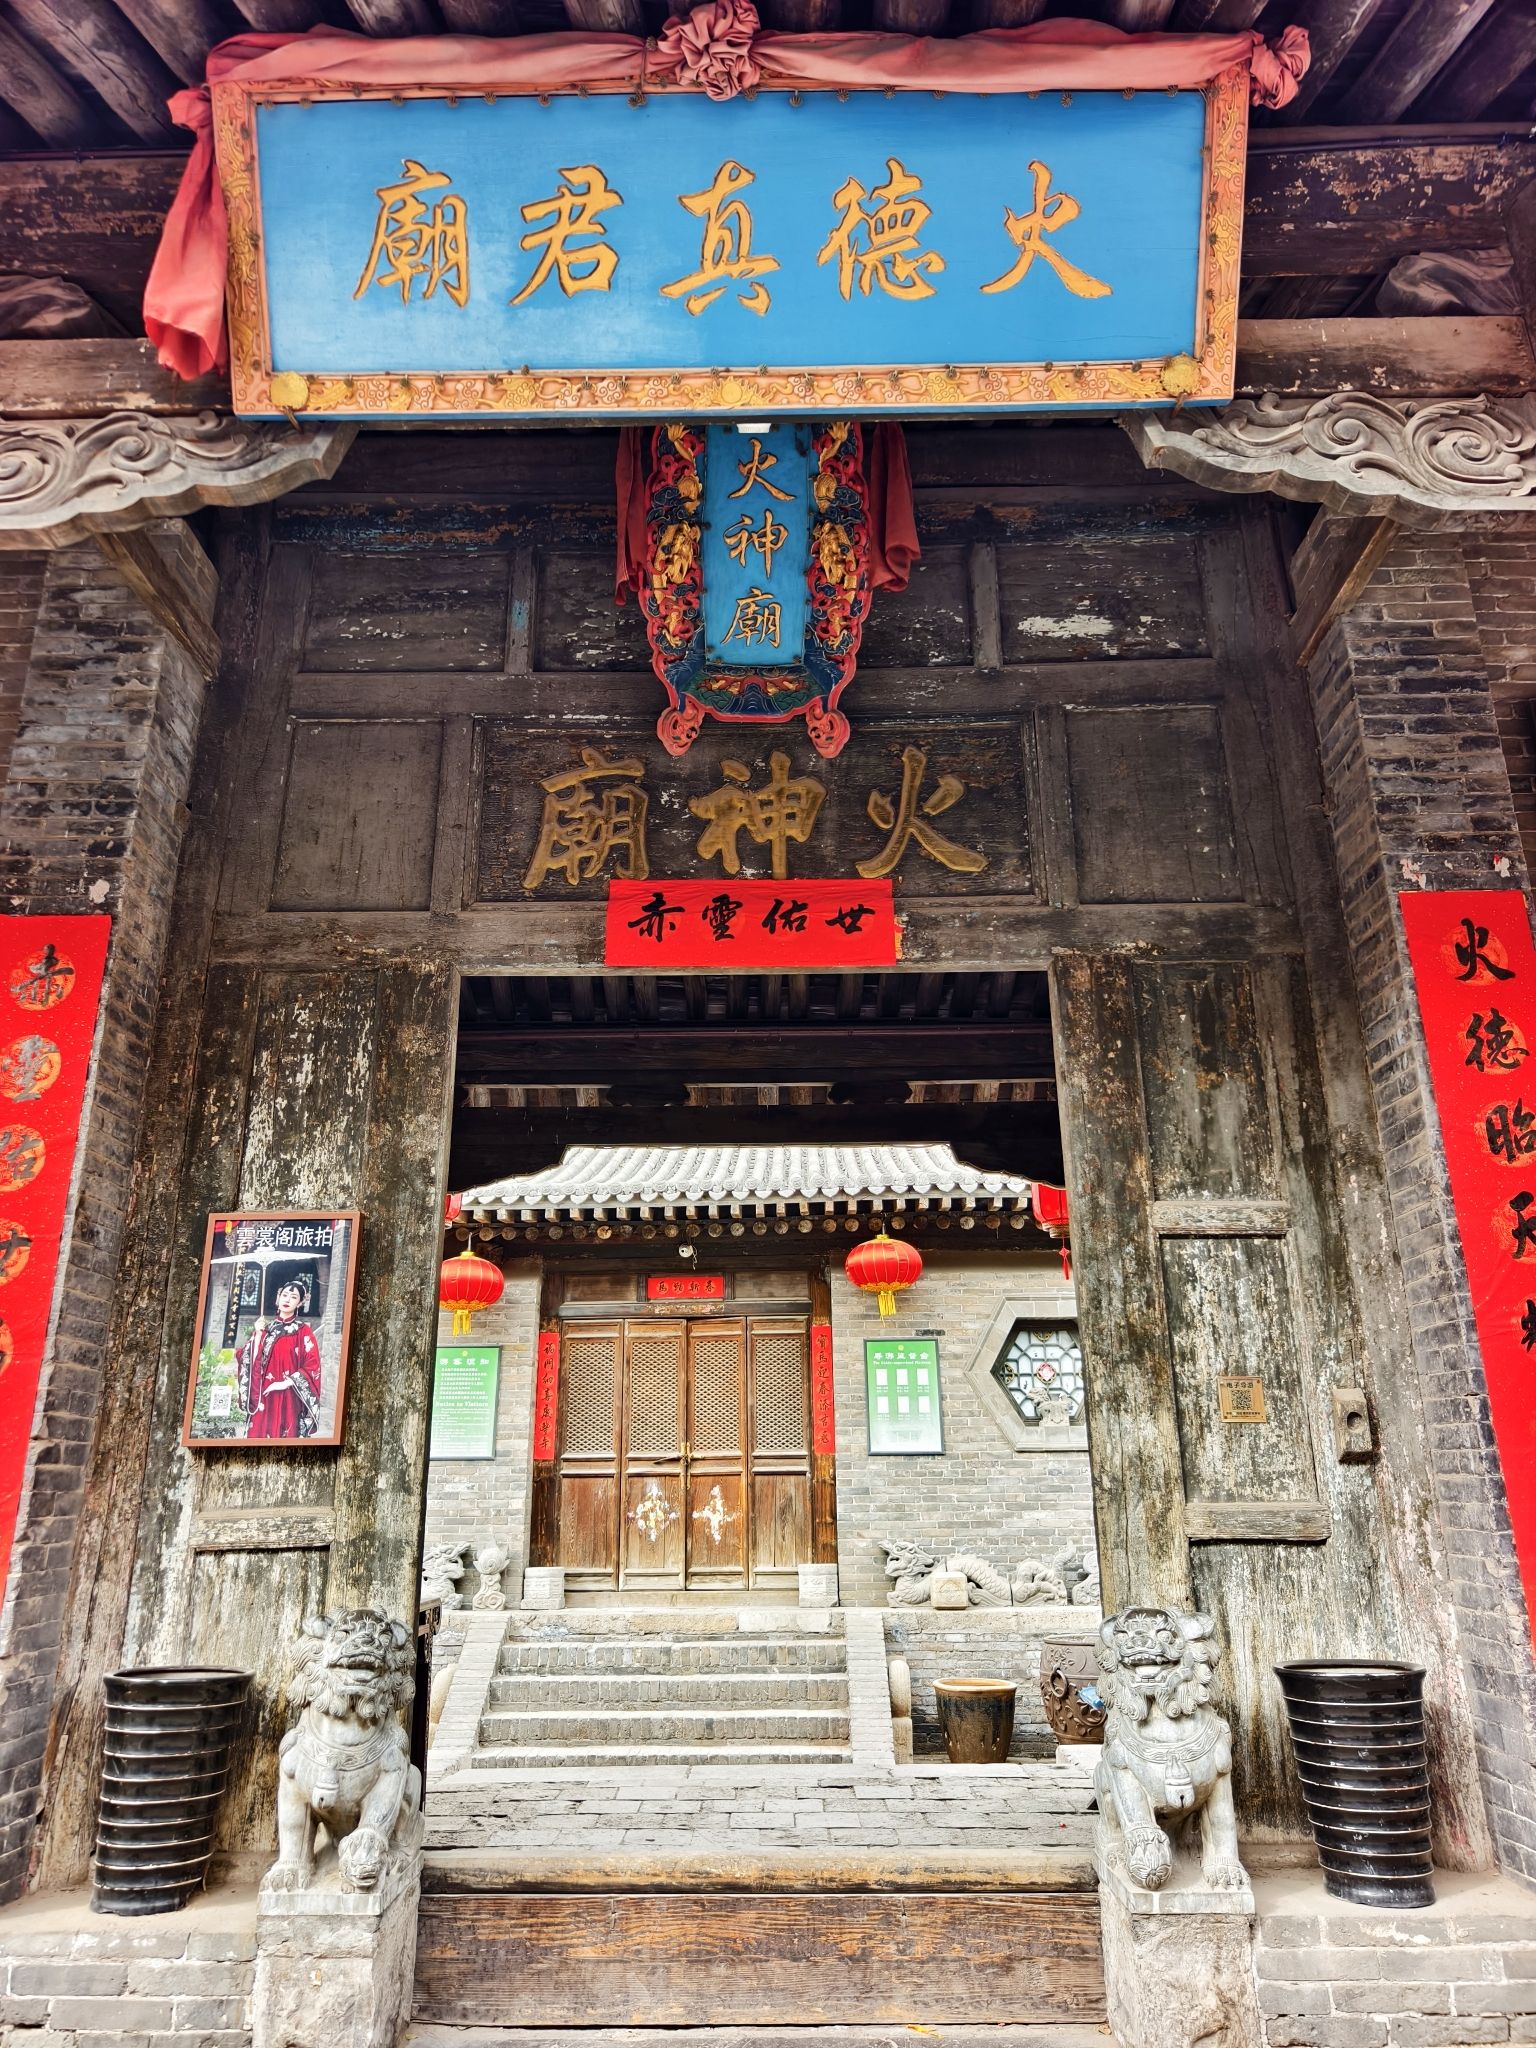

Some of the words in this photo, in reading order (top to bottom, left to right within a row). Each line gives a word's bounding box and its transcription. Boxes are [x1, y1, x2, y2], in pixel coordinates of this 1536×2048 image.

[720, 437, 797, 648] 火神廟
[521, 744, 990, 890] 火神廟
[1455, 917, 1536, 1353] 火德昭
